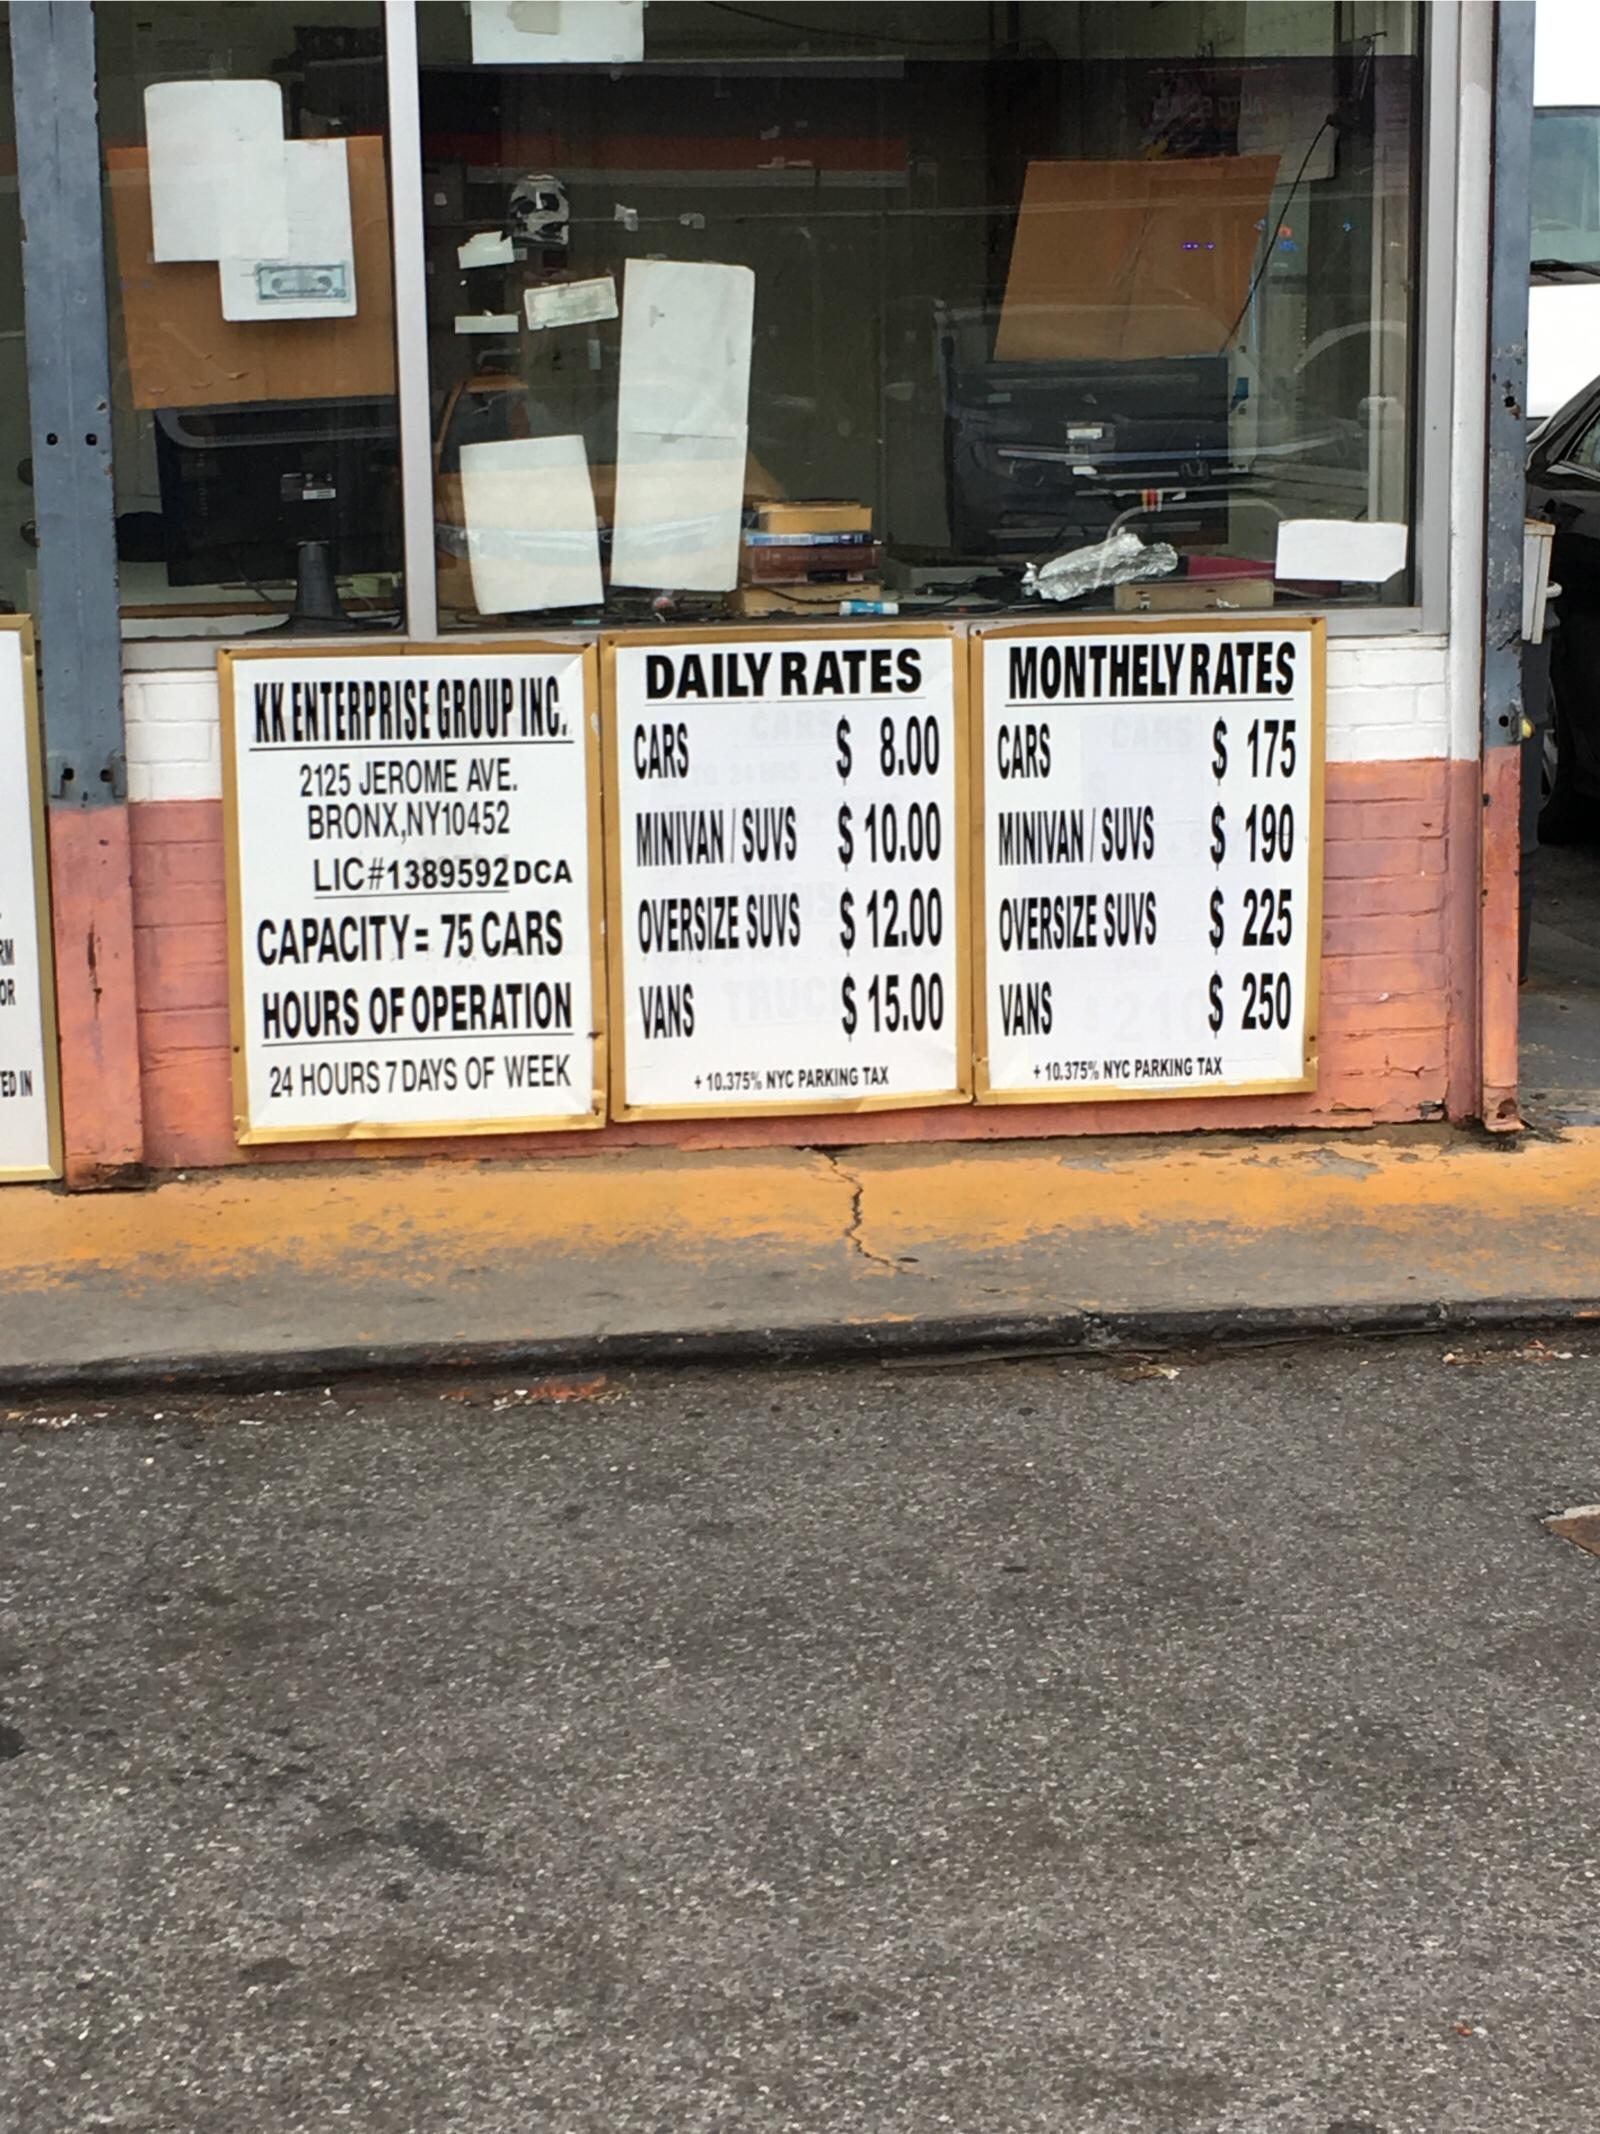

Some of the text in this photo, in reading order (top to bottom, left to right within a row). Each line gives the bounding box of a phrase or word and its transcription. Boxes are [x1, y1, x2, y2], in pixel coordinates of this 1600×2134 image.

[645, 647, 922, 700] DAILY RATES
[1008, 641, 1296, 701] MONTHELY RATES
[254, 675, 568, 743] KK ENTERPRISE GROUP INC.
[300, 757, 519, 797] 2125 JEROME AVE.
[634, 722, 689, 780] CARS
[880, 715, 940, 777] 8.00
[997, 724, 1051, 780] CARS
[1247, 718, 1296, 778] 175
[1210, 801, 1226, 871] $
[1245, 803, 1294, 863] 190
[440, 913, 474, 959] 75
[481, 909, 563, 958] CARS
[638, 894, 740, 954] OVERSIZE
[746, 891, 801, 949] SUVS
[999, 886, 1293, 955] OVERSIZE SUVS $ 225
[262, 981, 572, 1040] HOURS OF OPERATION
[639, 983, 695, 1039] VANS
[999, 970, 1292, 1039] VANS $ 250
[20, 1071, 33, 1097] IN
[270, 1054, 571, 1098] 24 HOURS 7 DAYS OF WEEK
[766, 1070, 794, 1088] NYC
[798, 1067, 859, 1087] PARKING
[863, 1066, 889, 1084] TAX
[1103, 1060, 1130, 1079] NYC
[1134, 1057, 1193, 1078] PARKING
[1197, 1056, 1222, 1076] TAX
